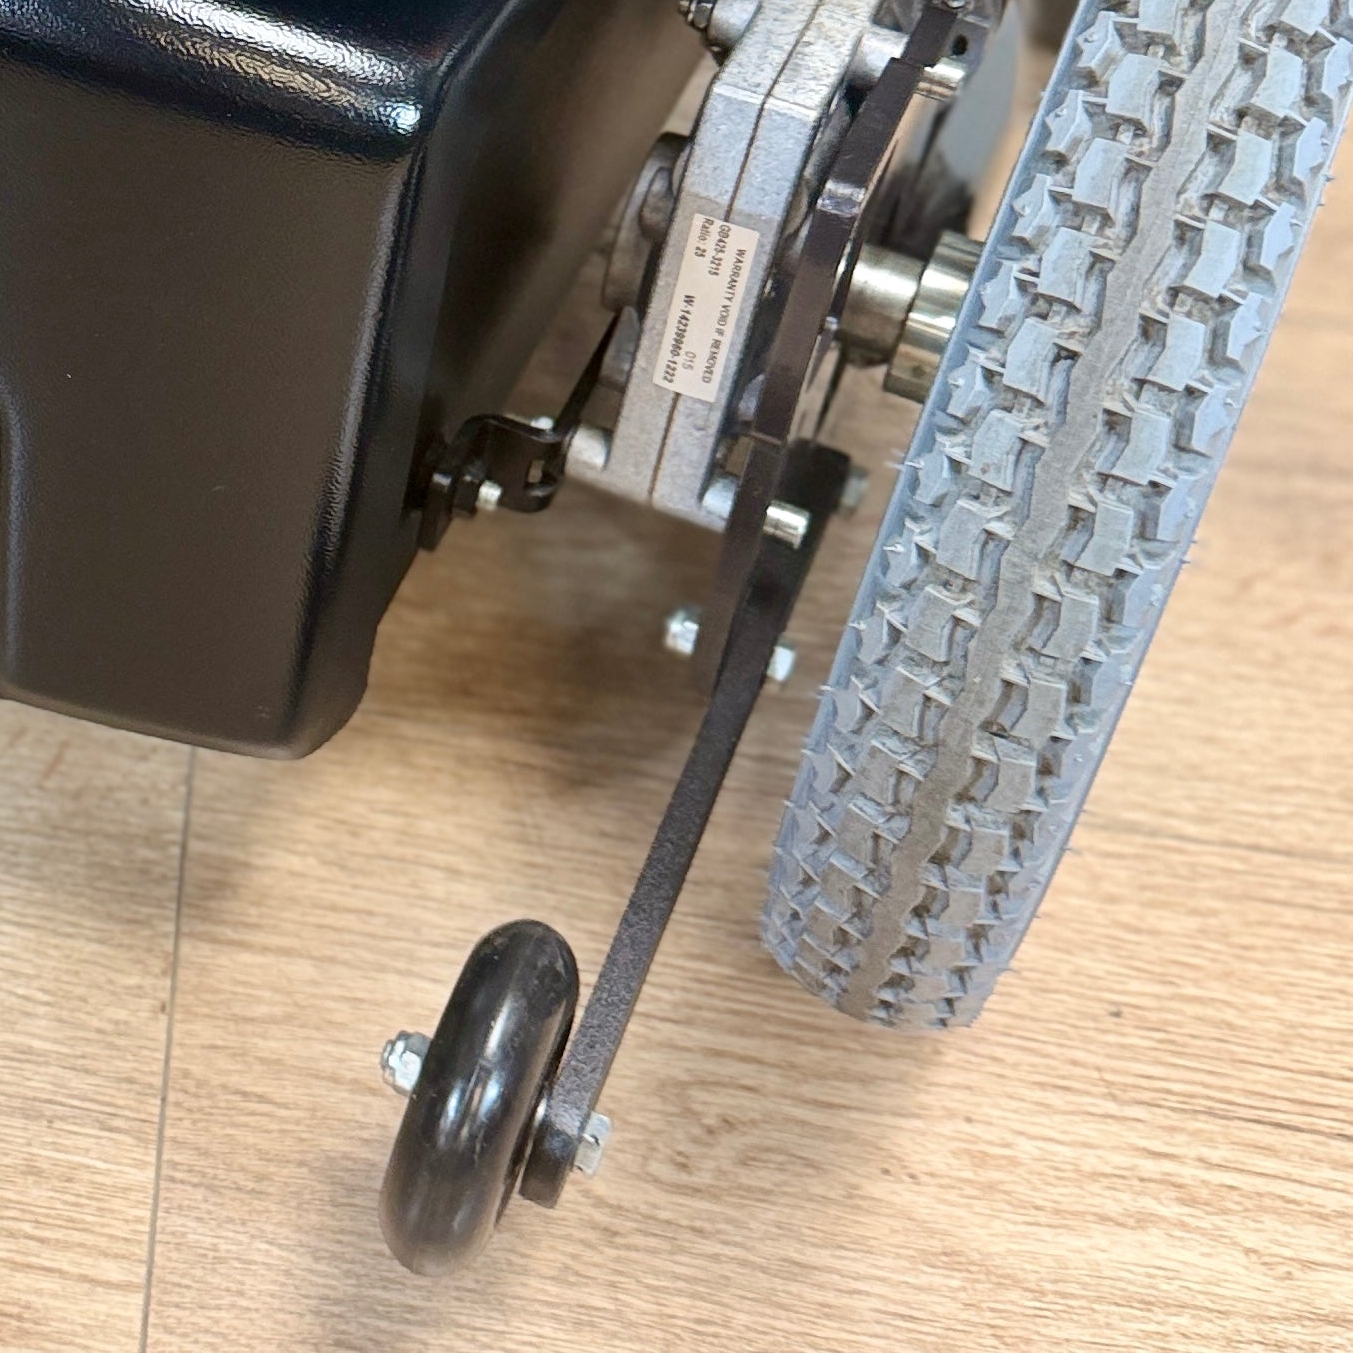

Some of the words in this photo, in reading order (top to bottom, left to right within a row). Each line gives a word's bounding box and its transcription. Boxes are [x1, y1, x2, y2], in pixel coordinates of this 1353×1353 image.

[724, 249, 747, 304] WARRANTY
[715, 327, 725, 337] IF
[717, 304, 731, 327] VOID
[702, 338, 722, 384] REMOVED
